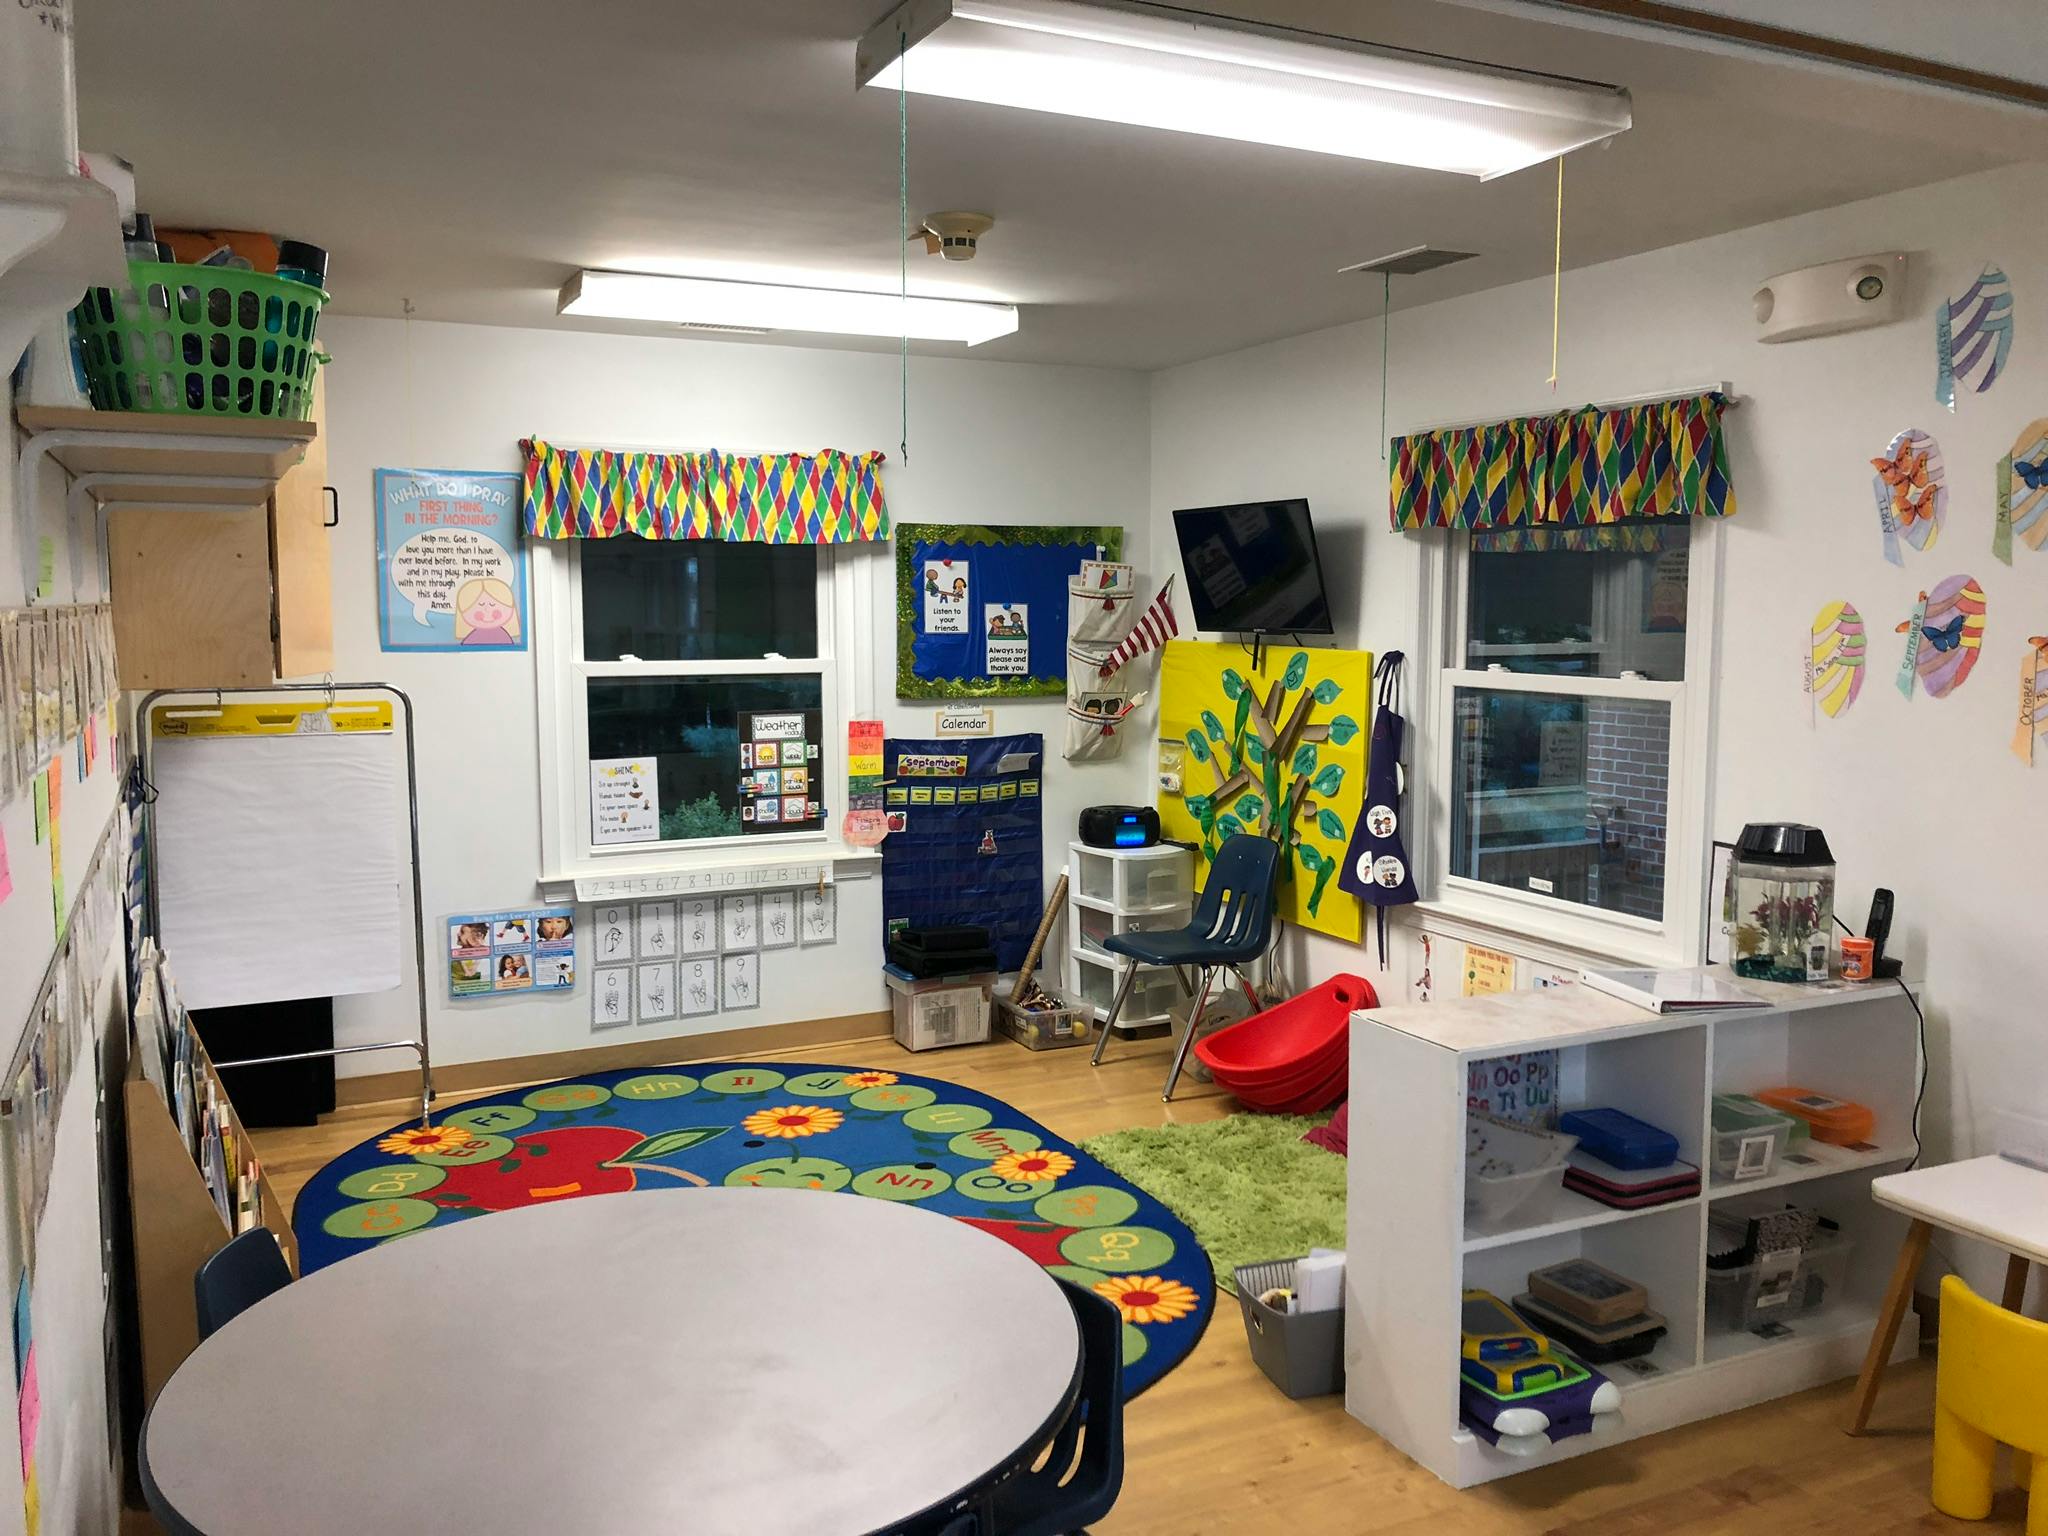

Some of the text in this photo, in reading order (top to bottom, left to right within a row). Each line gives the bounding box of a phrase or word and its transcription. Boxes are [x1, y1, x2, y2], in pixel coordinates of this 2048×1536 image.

[390, 480, 432, 505] WHAT
[436, 482, 457, 497] DO
[473, 484, 511, 507] PRAY
[420, 501, 483, 513] FIRST THING
[1879, 498, 1893, 533] APRIL
[1999, 492, 2009, 524] MAY
[404, 512, 498, 526] IN THE MORNING?
[421, 535, 436, 544] Help
[406, 546, 420, 554] love
[422, 548, 435, 556] you
[456, 546, 472, 554] than
[478, 546, 493, 555] have
[415, 557, 433, 565] loved
[485, 558, 501, 566] work
[422, 568, 429, 576] in
[432, 570, 442, 578] my
[464, 569, 484, 578] please
[486, 569, 495, 577] be
[429, 580, 456, 589] through
[1902, 614, 1923, 671] SEPTEMBER
[990, 656, 1012, 664] please
[1804, 656, 1812, 693] AUGUST
[2020, 678, 2034, 725] OCTOBER
[942, 719, 987, 729] Calendar
[855, 761, 877, 770] Warm
[592, 882, 603, 896] 2
[609, 881, 615, 895] 3
[624, 880, 632, 893] 4
[640, 879, 647, 892] 5
[656, 878, 664, 891] 6
[672, 877, 680, 890] 7
[689, 875, 696, 888] 8
[705, 874, 712, 887] 9
[721, 872, 735, 886] 10
[757, 870, 770, 883] 12
[777, 869, 788, 881] 13
[797, 867, 808, 880] 14
[694, 903, 704, 917] 2
[736, 900, 744, 913] 3
[774, 896, 782, 909] 4
[815, 892, 823, 906] 5
[607, 959, 745, 987] 6 7 8 9
[732, 1076, 755, 1086] Ii
[1494, 1066, 1520, 1087] Oo
[1526, 1062, 1549, 1085] Pp
[632, 1081, 682, 1095] Hh
[1526, 1086, 1549, 1107] Uu
[470, 1111, 511, 1130] Ff
[439, 1140, 491, 1158] Ee
[967, 1131, 1016, 1156] Mm
[368, 1172, 419, 1193] Dd
[875, 1172, 935, 1191] Nn
[972, 1176, 1033, 1194] Oo
[362, 1203, 404, 1231] Cc
[1087, 1232, 1140, 1263] Qq
